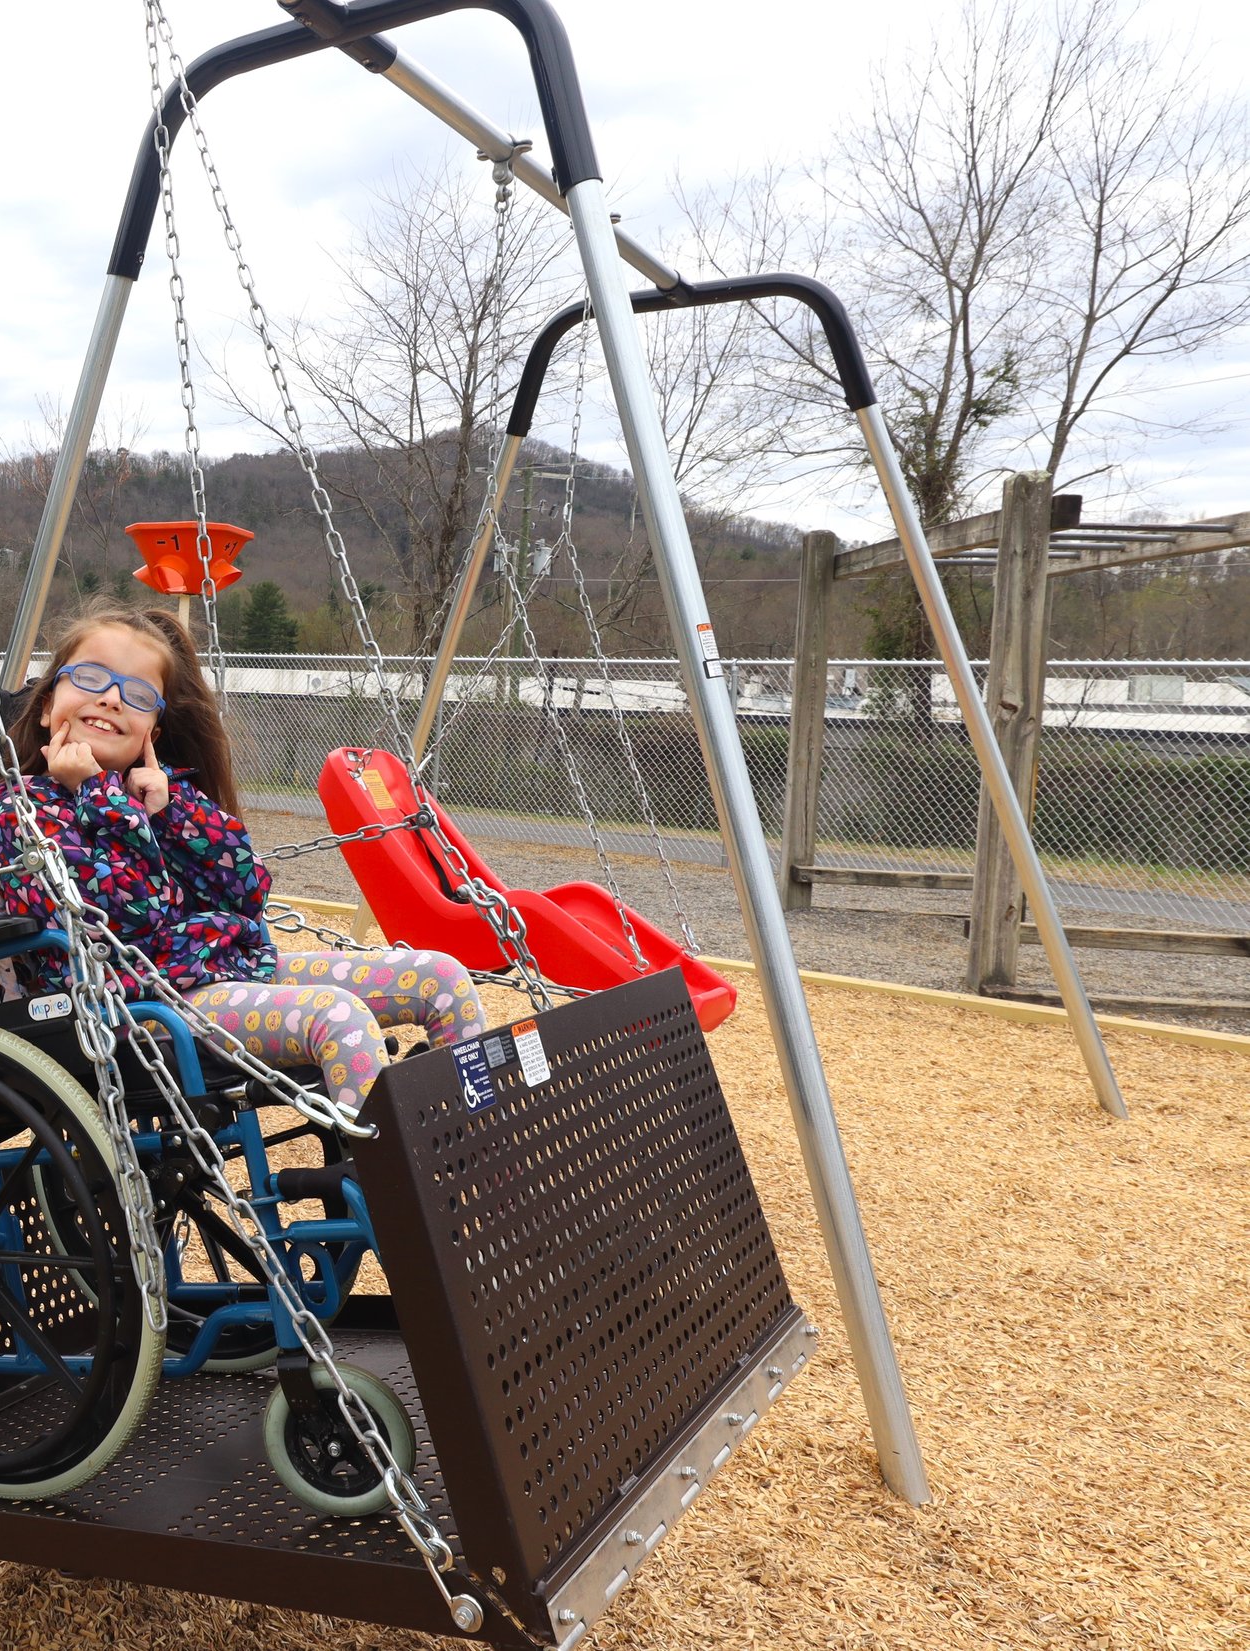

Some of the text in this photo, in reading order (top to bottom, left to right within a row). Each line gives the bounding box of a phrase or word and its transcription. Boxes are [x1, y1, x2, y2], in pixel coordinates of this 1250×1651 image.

[31, 998, 69, 1018] Inspired
[452, 1041, 480, 1057] WHEELCHAIR
[458, 1051, 479, 1065] USE ONLY
